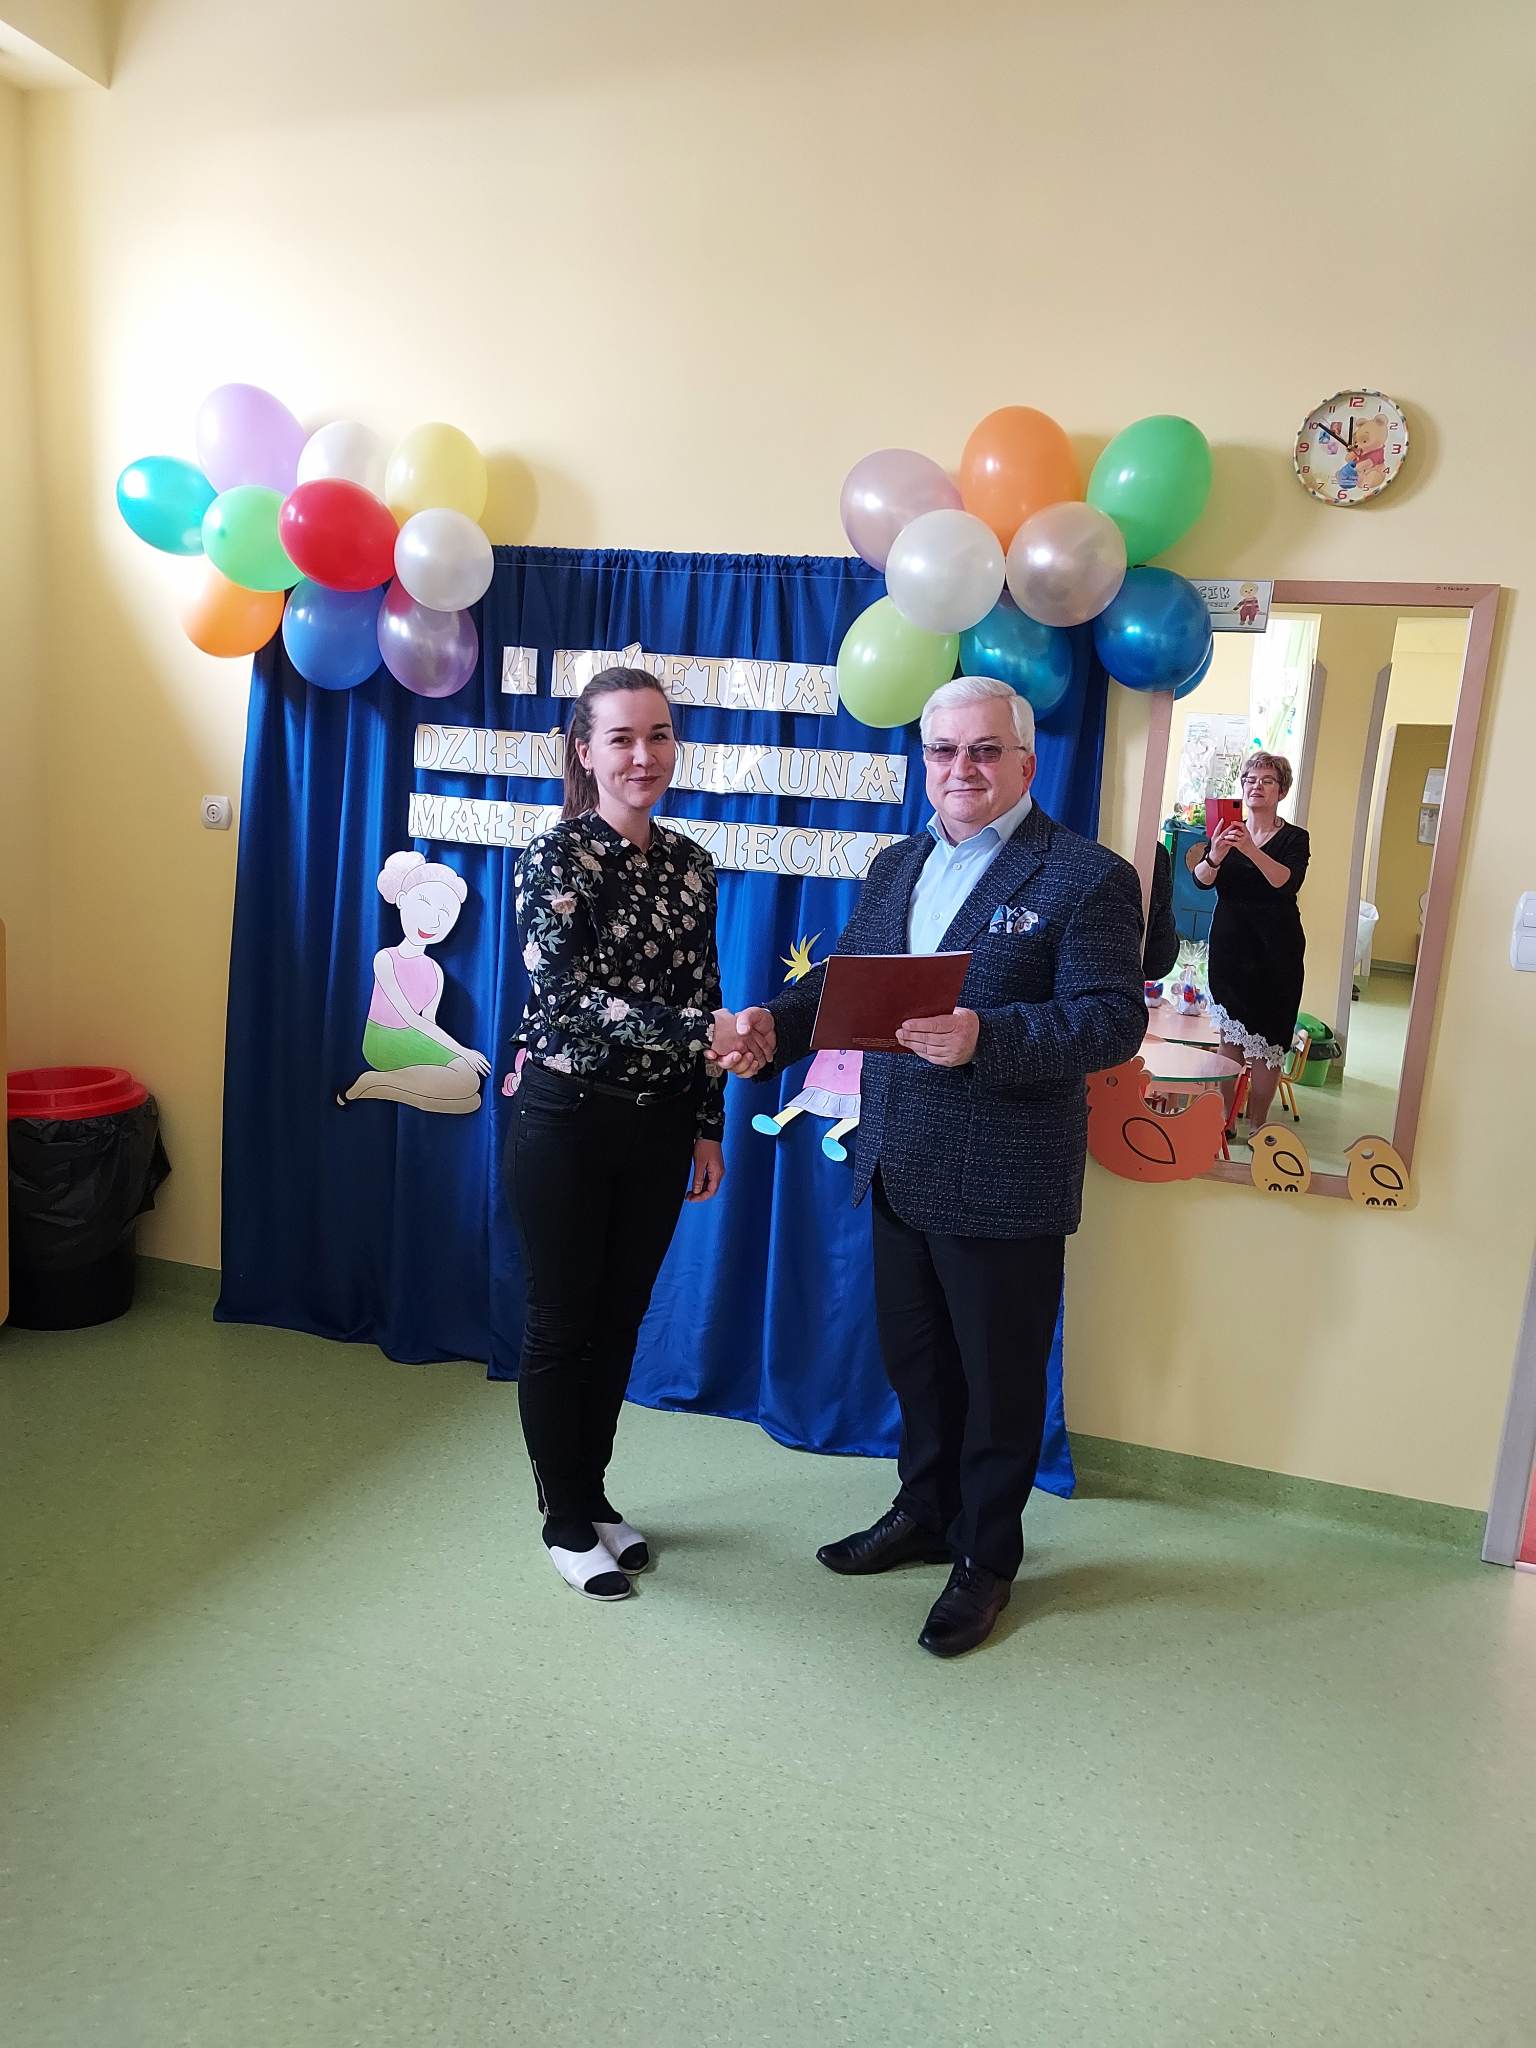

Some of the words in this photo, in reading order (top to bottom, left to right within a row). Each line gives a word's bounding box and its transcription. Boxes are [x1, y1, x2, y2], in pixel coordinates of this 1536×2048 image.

[1348, 396, 1365, 408] 12
[1328, 405, 1336, 414] 11
[1378, 405, 1382, 413] 1
[1308, 422, 1319, 430] 10
[1389, 422, 1398, 430] 2
[1298, 442, 1310, 453] 9
[1391, 443, 1402, 455] 3
[1302, 465, 1311, 474] 8
[1383, 466, 1390, 475] 4
[1317, 482, 1325, 490] 7
[1363, 484, 1370, 492] 5
[1337, 489, 1347, 500] 6
[504, 649, 536, 693] 4
[414, 724, 565, 778] DZIEŃ
[675, 742, 902, 802] IEKUNA
